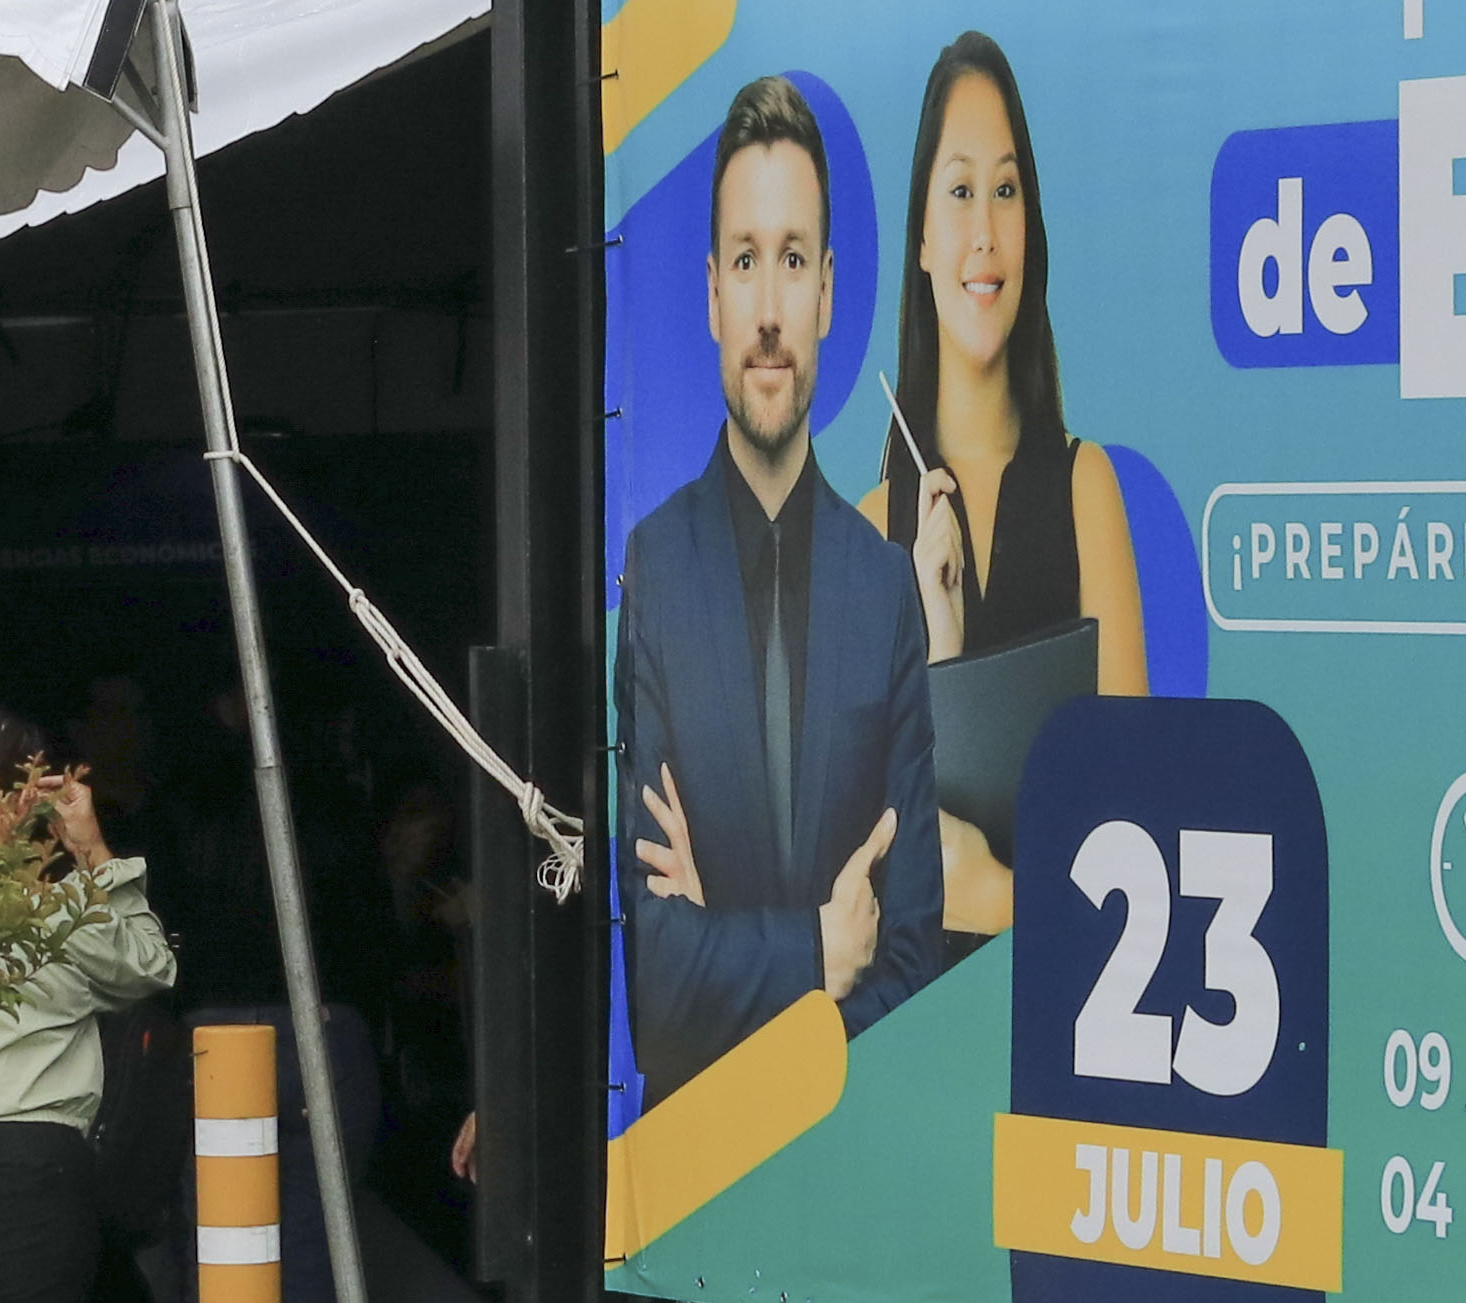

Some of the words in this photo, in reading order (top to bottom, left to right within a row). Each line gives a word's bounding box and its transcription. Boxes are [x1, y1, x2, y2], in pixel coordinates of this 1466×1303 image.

[1237, 177, 1374, 339] de
[1069, 819, 1281, 1096] 23
[1383, 1028, 1452, 1111] 09
[1069, 1142, 1282, 1266] JULIO
[1380, 1154, 1453, 1239] 04
